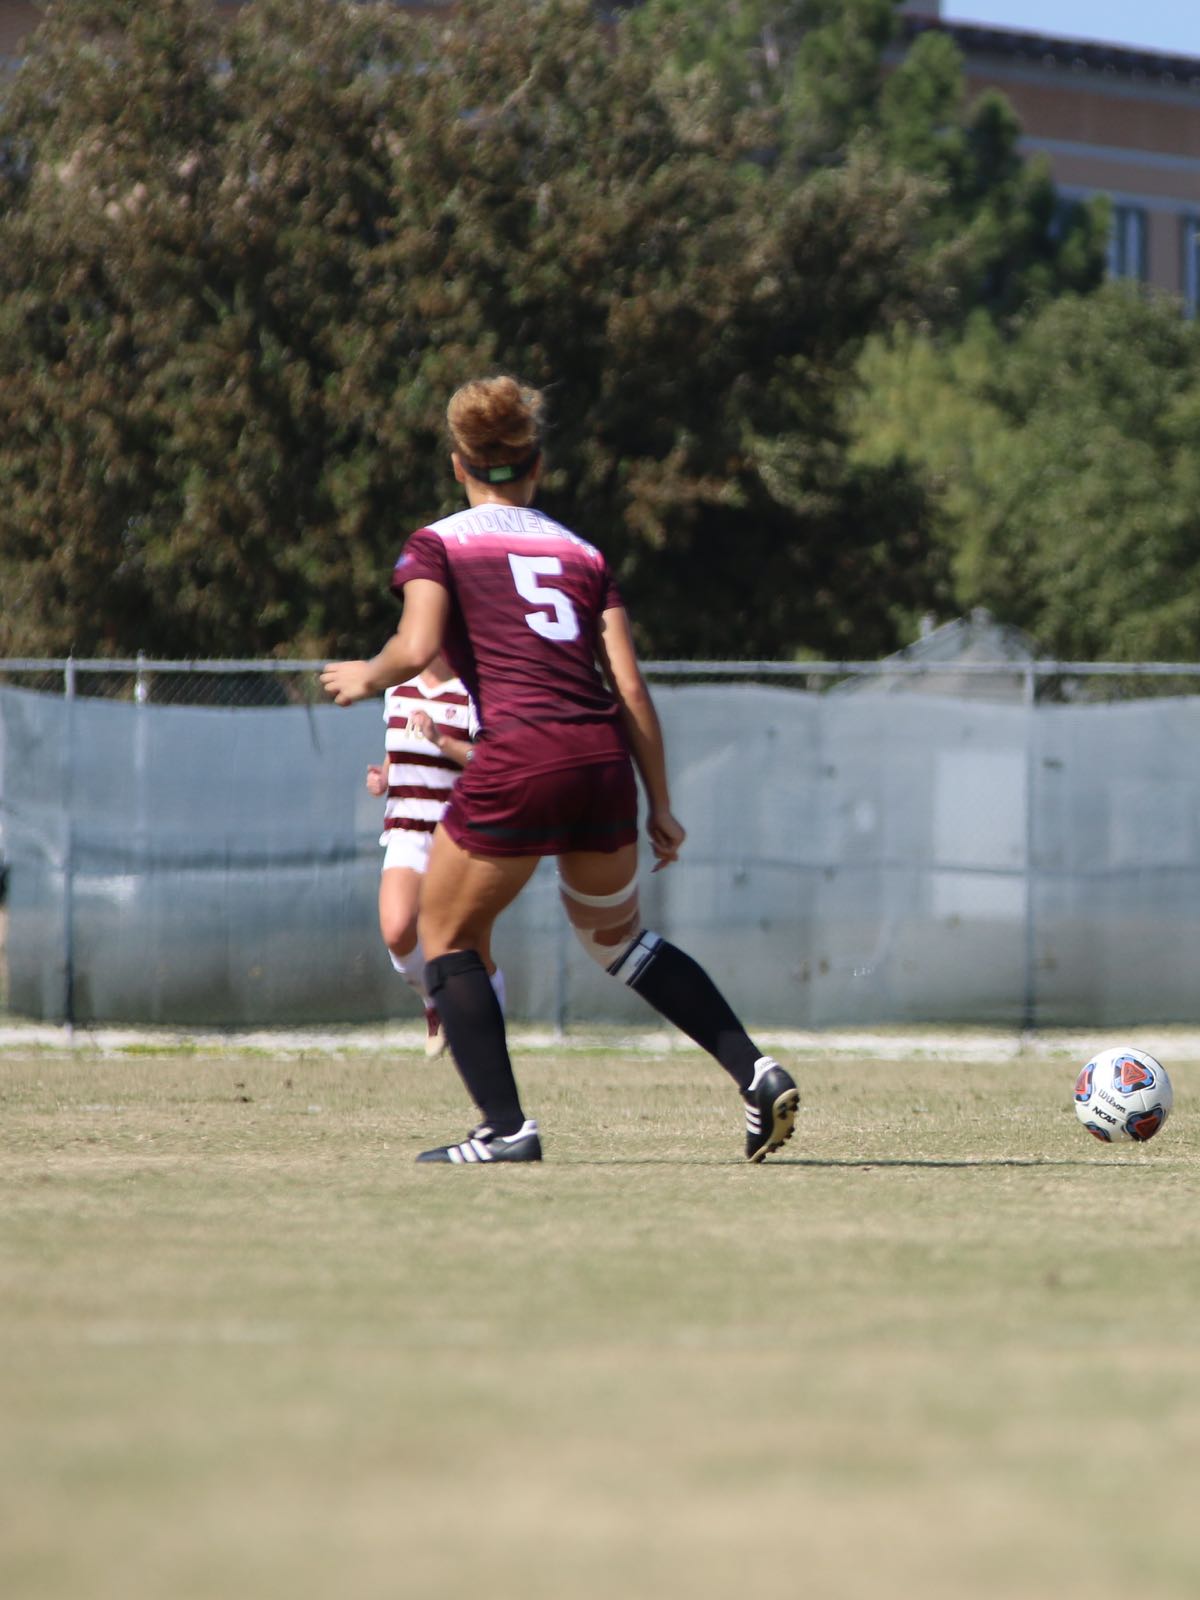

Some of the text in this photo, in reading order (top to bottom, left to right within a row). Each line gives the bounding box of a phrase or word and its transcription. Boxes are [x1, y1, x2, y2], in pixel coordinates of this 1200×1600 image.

[507, 553, 580, 642] 5
[1097, 1088, 1126, 1113] Wilson
[1091, 1106, 1117, 1126] NCAA
